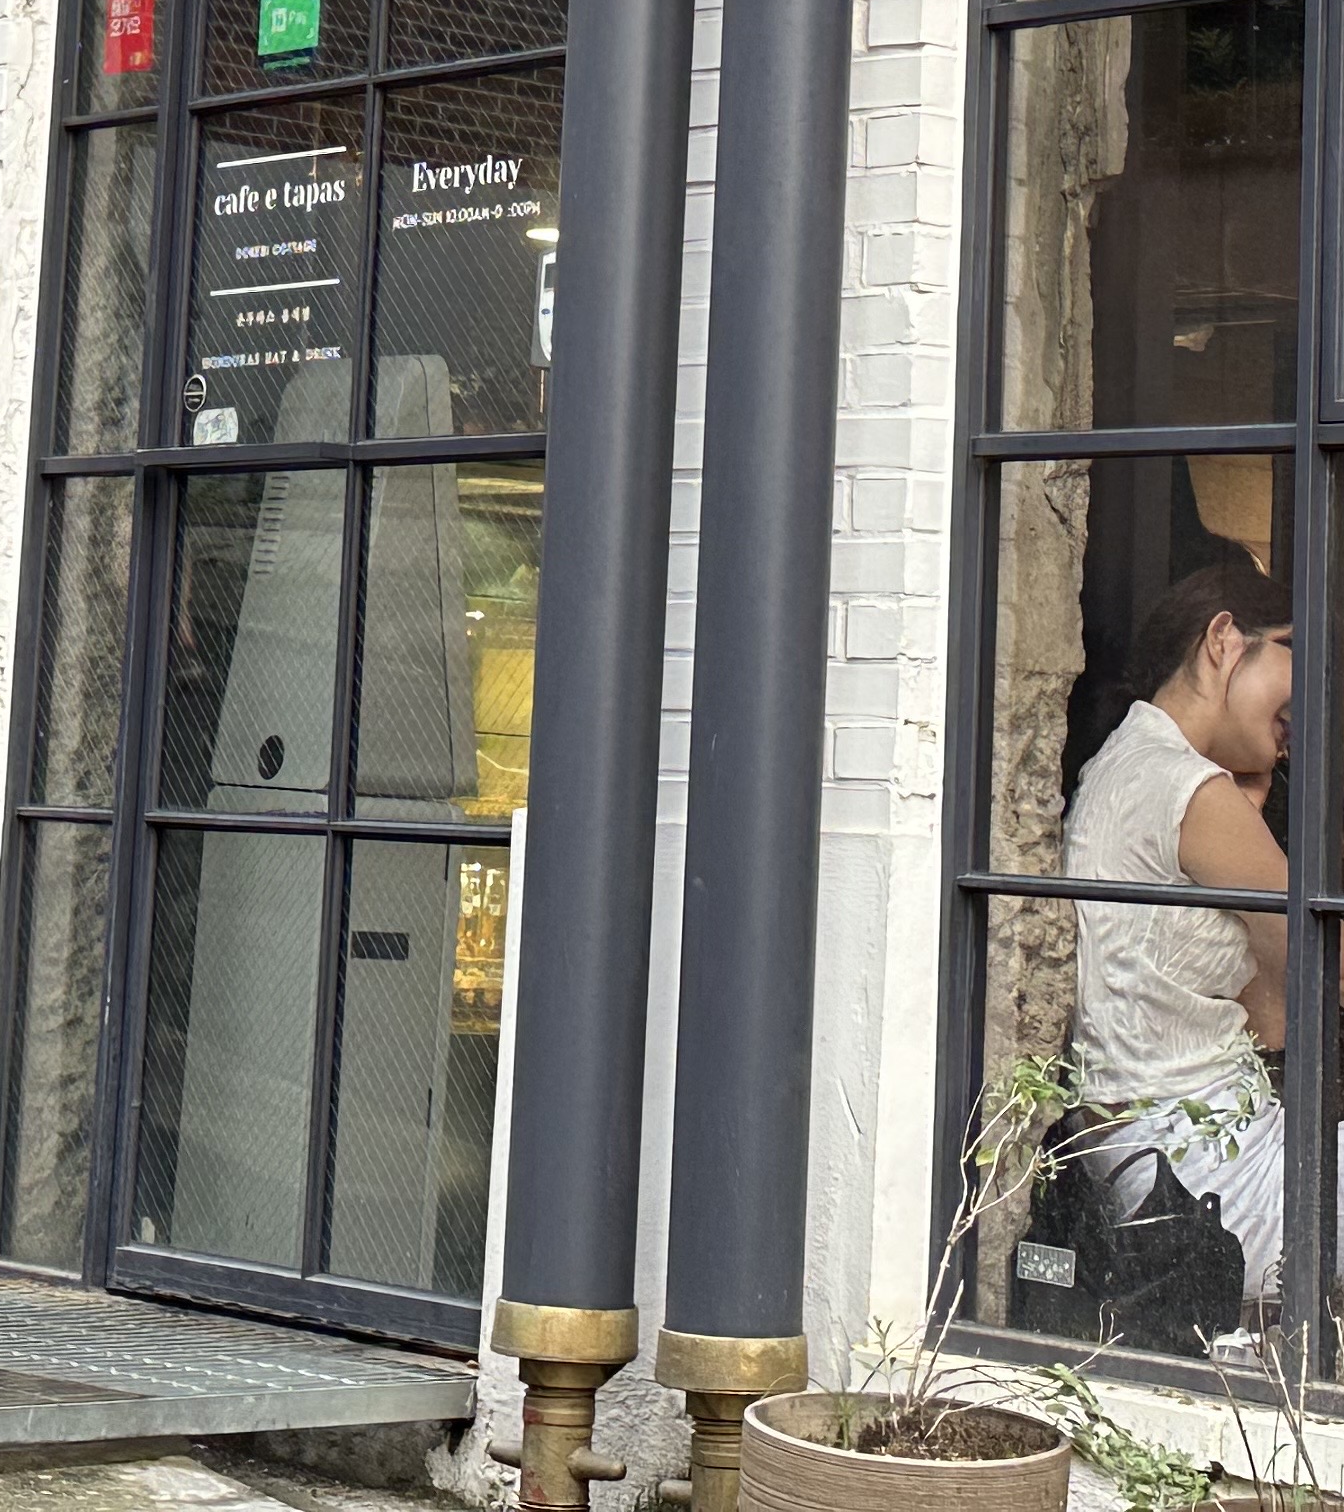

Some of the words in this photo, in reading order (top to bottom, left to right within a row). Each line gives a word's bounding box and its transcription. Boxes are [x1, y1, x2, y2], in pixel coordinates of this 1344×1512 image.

[412, 155, 523, 194] Everyday
[214, 185, 259, 215] cafe
[265, 188, 277, 209] e
[284, 179, 345, 212] tapas
